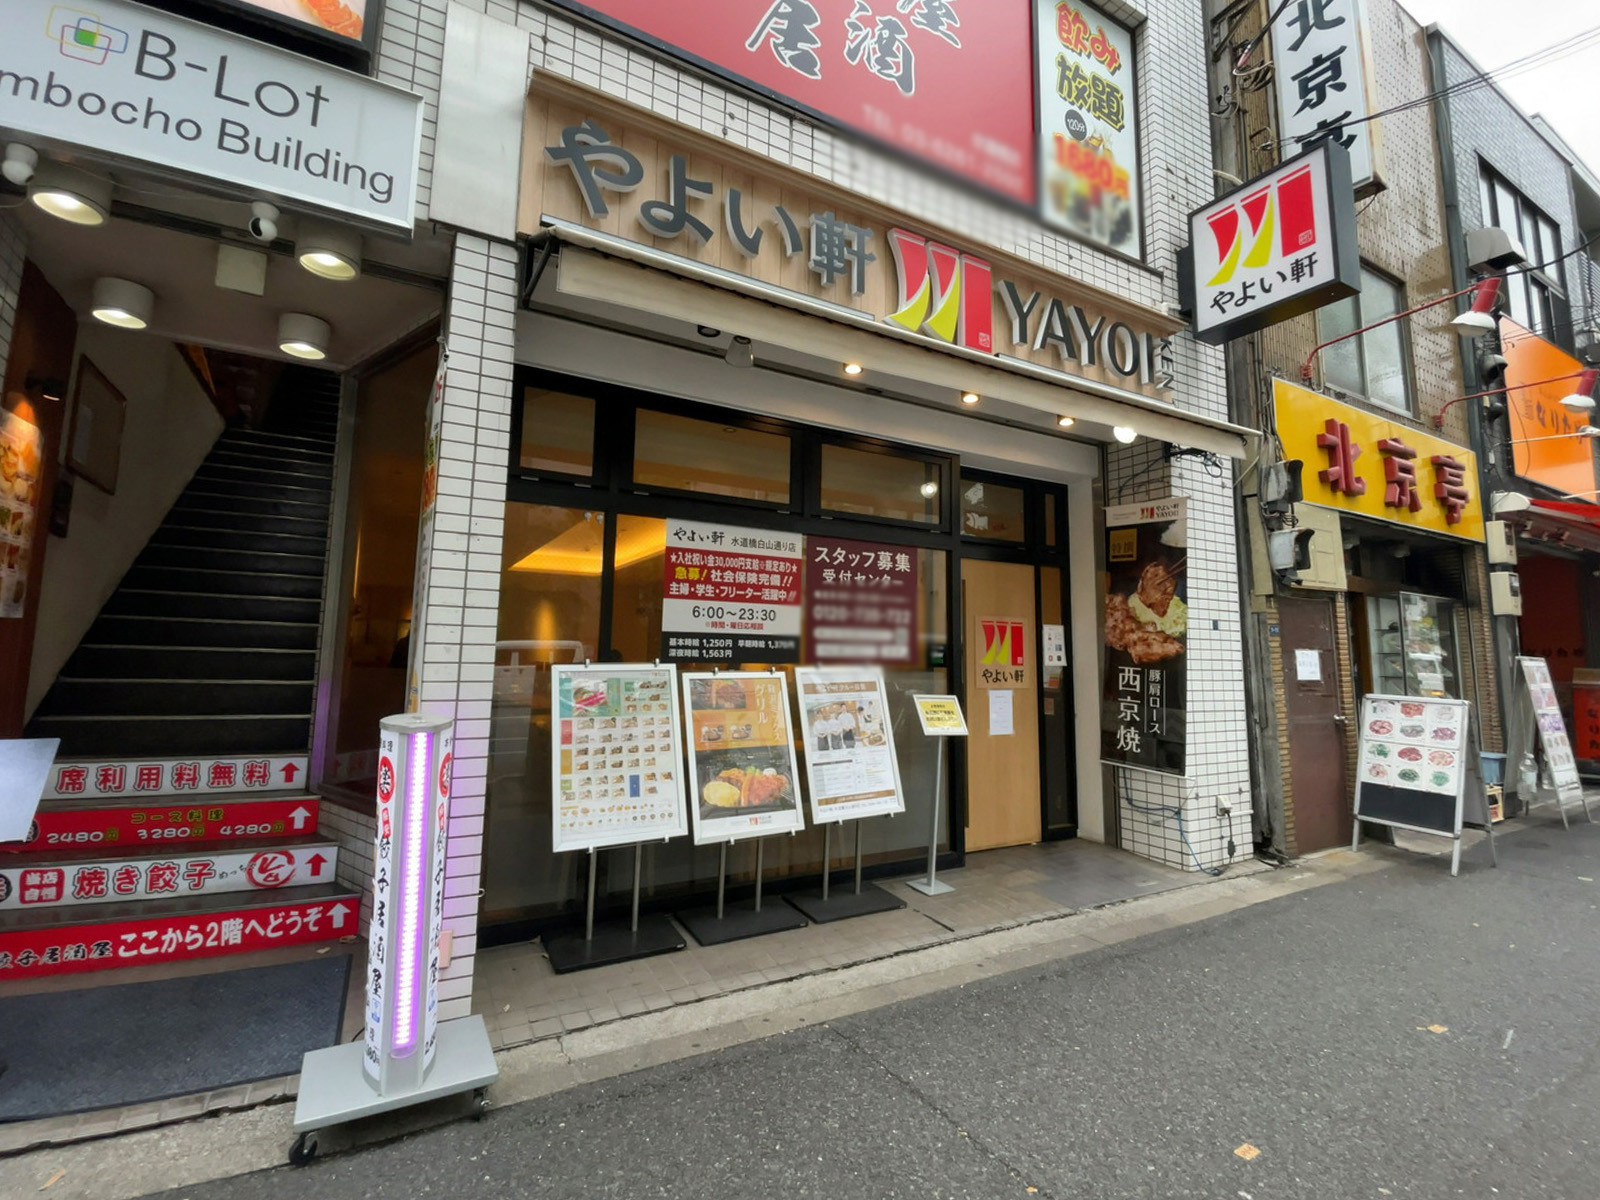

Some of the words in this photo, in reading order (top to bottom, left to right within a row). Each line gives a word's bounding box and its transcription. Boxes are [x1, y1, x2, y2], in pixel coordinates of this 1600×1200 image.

[1055, 2, 1122, 75] 飲み
[135, 29, 330, 127] B-Lot
[1055, 52, 1125, 132] 放題
[217, 117, 395, 204] Building
[544, 118, 877, 298] やよい軒
[1210, 251, 1318, 314] やよい軒
[997, 280, 1155, 385] YAYOI
[1316, 418, 1470, 526] 北京亭
[673, 527, 725, 546] やよい軒
[731, 536, 796, 552] 水道橋白山通り店
[815, 546, 911, 573] スタッフ募集
[702, 638, 732, 648] 1,250円
[702, 649, 732, 658] 1,563円
[982, 669, 1024, 683] やよい軒
[1149, 669, 1161, 735] 豚肩ロース
[1117, 666, 1141, 753] 西京焼
[57, 760, 270, 794] 席利用料無料
[131, 808, 223, 824] コース料理
[73, 859, 216, 899] 焼き餃子
[119, 906, 323, 957] ここから2階へどうぞ
